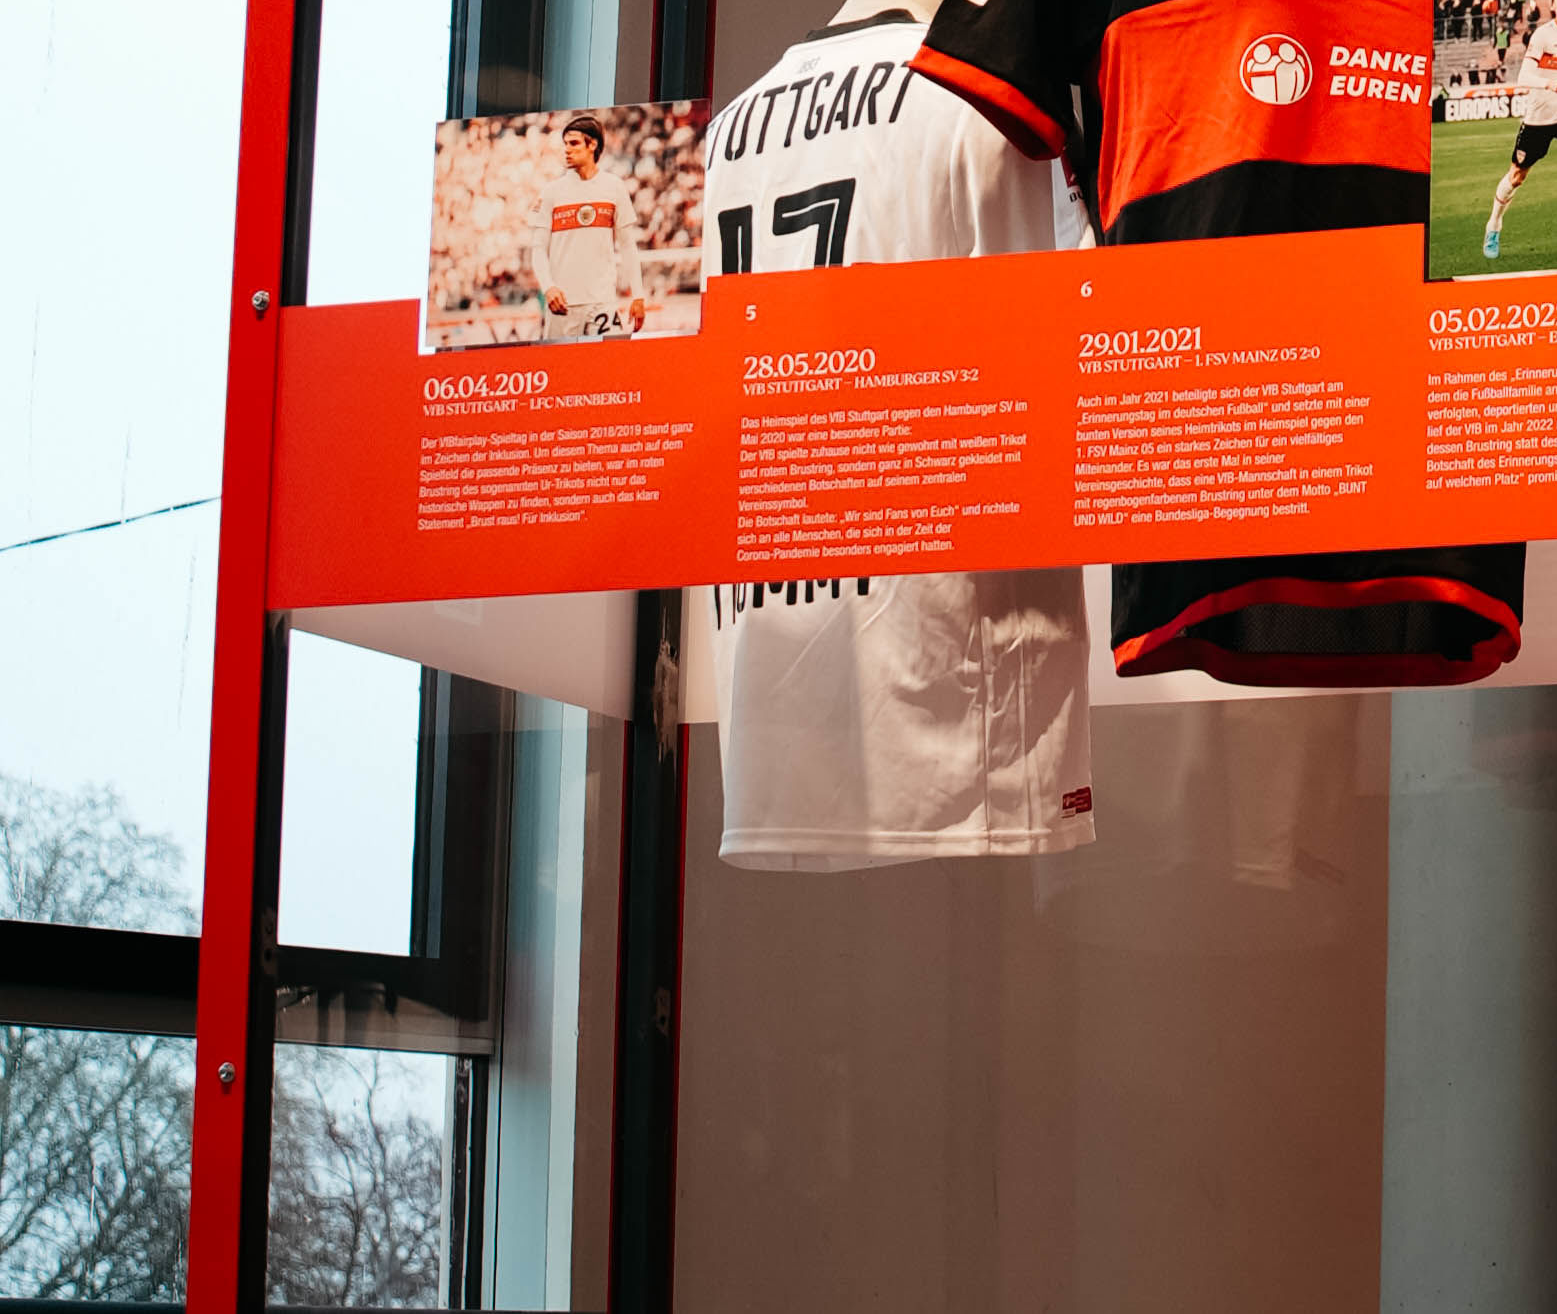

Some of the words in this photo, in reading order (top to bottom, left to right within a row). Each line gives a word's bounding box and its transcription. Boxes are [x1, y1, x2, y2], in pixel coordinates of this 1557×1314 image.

[1330, 45, 1429, 76] DANKE
[1330, 75, 1422, 105] EUREN
[1445, 96, 1510, 122] EUROPAS
[1080, 280, 1093, 298] 6
[595, 311, 622, 335] 24
[745, 304, 757, 321] 5
[1079, 326, 1202, 358] 29.01.2021
[1429, 337, 1453, 351] VfB
[1454, 331, 1537, 350] STUTTGART
[743, 348, 876, 380] 28.05.2020
[1079, 360, 1103, 374] VfB
[1103, 355, 1181, 373] STUTTGART
[1206, 351, 1231, 366] FSV
[1232, 348, 1279, 365] MAINZ
[1280, 346, 1298, 361] 05
[1299, 345, 1320, 360] 2:0
[423, 370, 549, 401] 06.04.2019
[743, 383, 766, 396] VfB
[767, 376, 843, 394] STUTTGART
[854, 371, 941, 390] HAMBURGER
[942, 369, 960, 382] SV
[960, 367, 979, 382] 3:2
[1427, 373, 1441, 385] Im
[1442, 372, 1486, 385] Rahmen
[1488, 370, 1508, 382] des
[447, 398, 519, 416] STUTTGART
[1076, 395, 1102, 408] Auch
[1104, 396, 1117, 406] im
[1119, 393, 1142, 405] Jahr
[1143, 390, 1168, 404] 2021
[1171, 388, 1217, 402] beteiligte
[1219, 386, 1240, 399] sich
[1242, 386, 1260, 397] der
[1260, 383, 1279, 396] VfB
[1280, 381, 1325, 396] Stuttgart
[1326, 381, 1344, 392] am
[742, 417, 759, 429] Das
[810, 413, 827, 425] des
[829, 411, 845, 423] VfB
[891, 408, 920, 422] gegen
[922, 406, 941, 418] den
[999, 400, 1012, 413] SV
[1015, 401, 1027, 411] im
[1427, 406, 1480, 421] verfolgten,
[1483, 402, 1545, 418] deportierten
